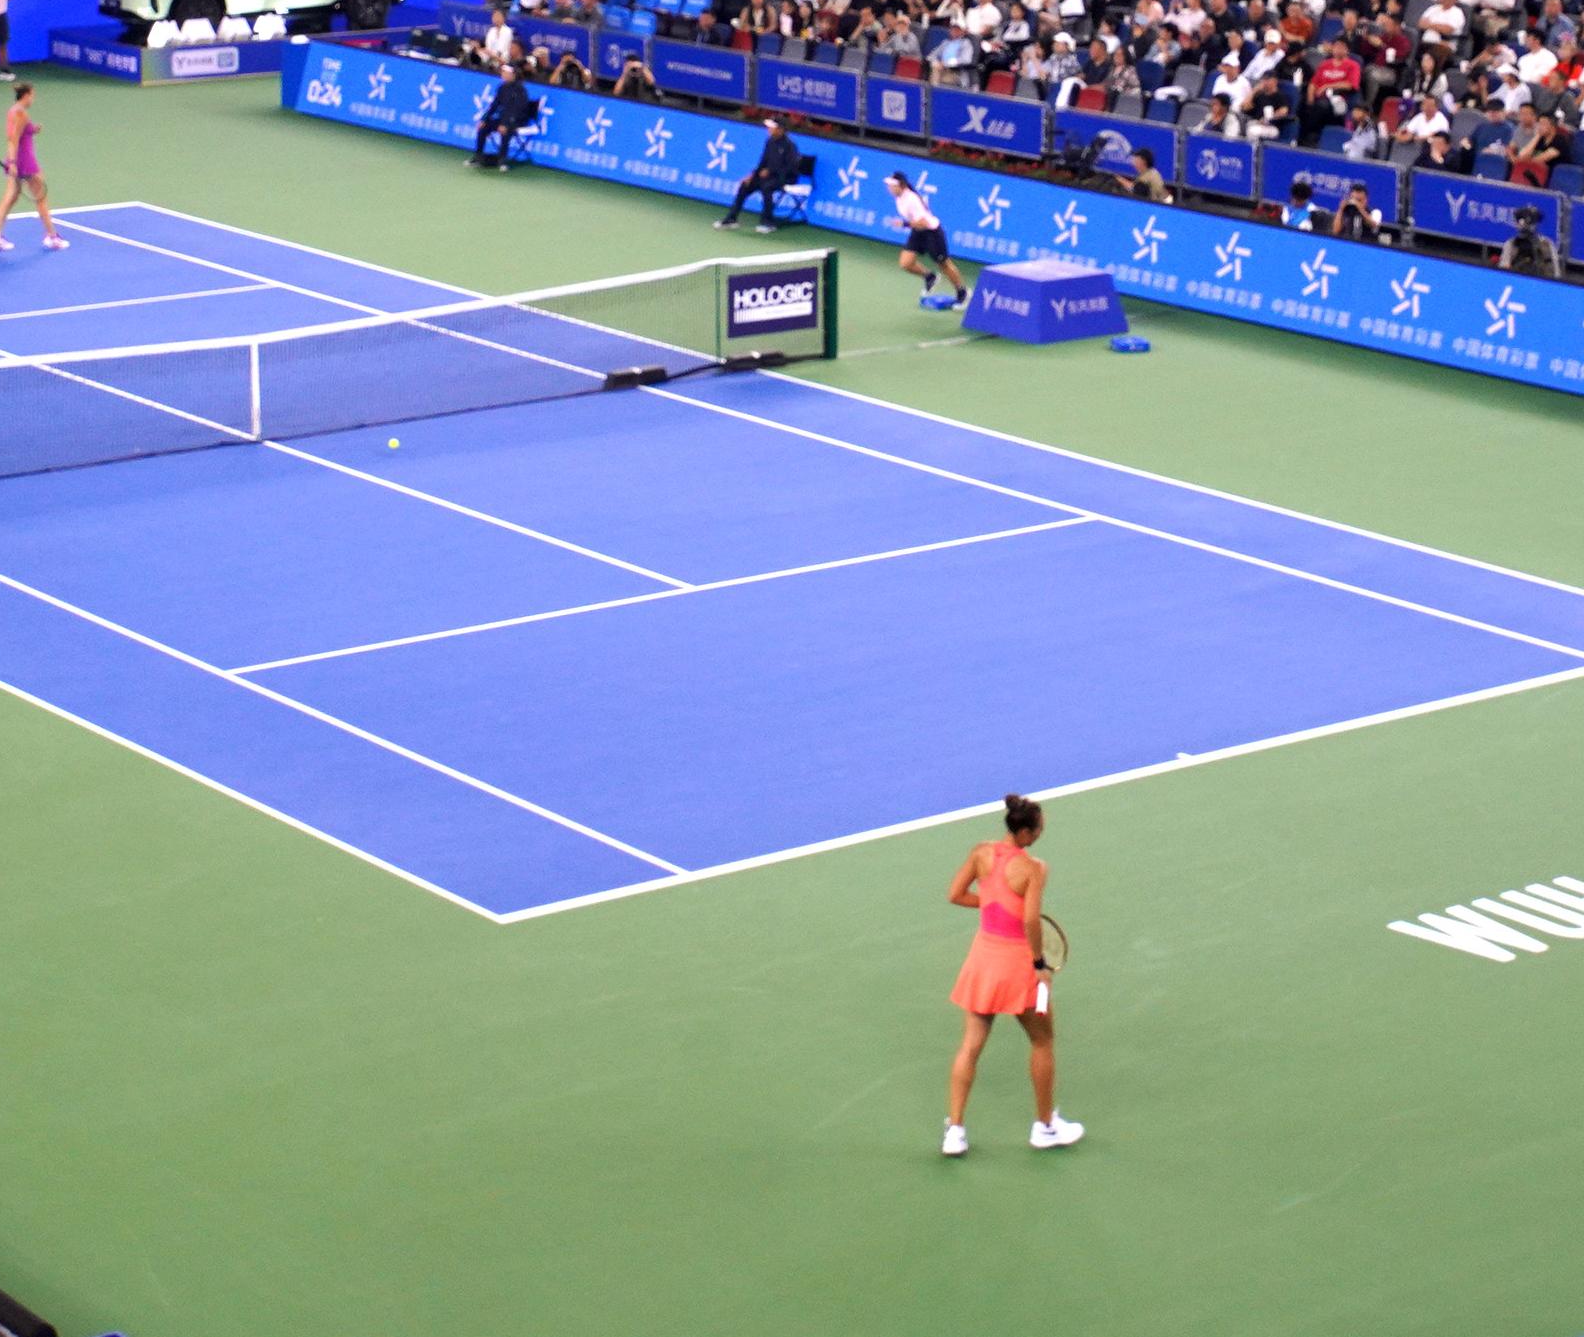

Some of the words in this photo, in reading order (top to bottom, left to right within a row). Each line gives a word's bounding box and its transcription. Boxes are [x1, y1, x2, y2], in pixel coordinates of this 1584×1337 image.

[307, 80, 343, 107] 0:24
[733, 281, 814, 309] HOLOGIC
[1359, 316, 1444, 350] 中国体育彩票
[1452, 336, 1541, 372] 中国体育彩票
